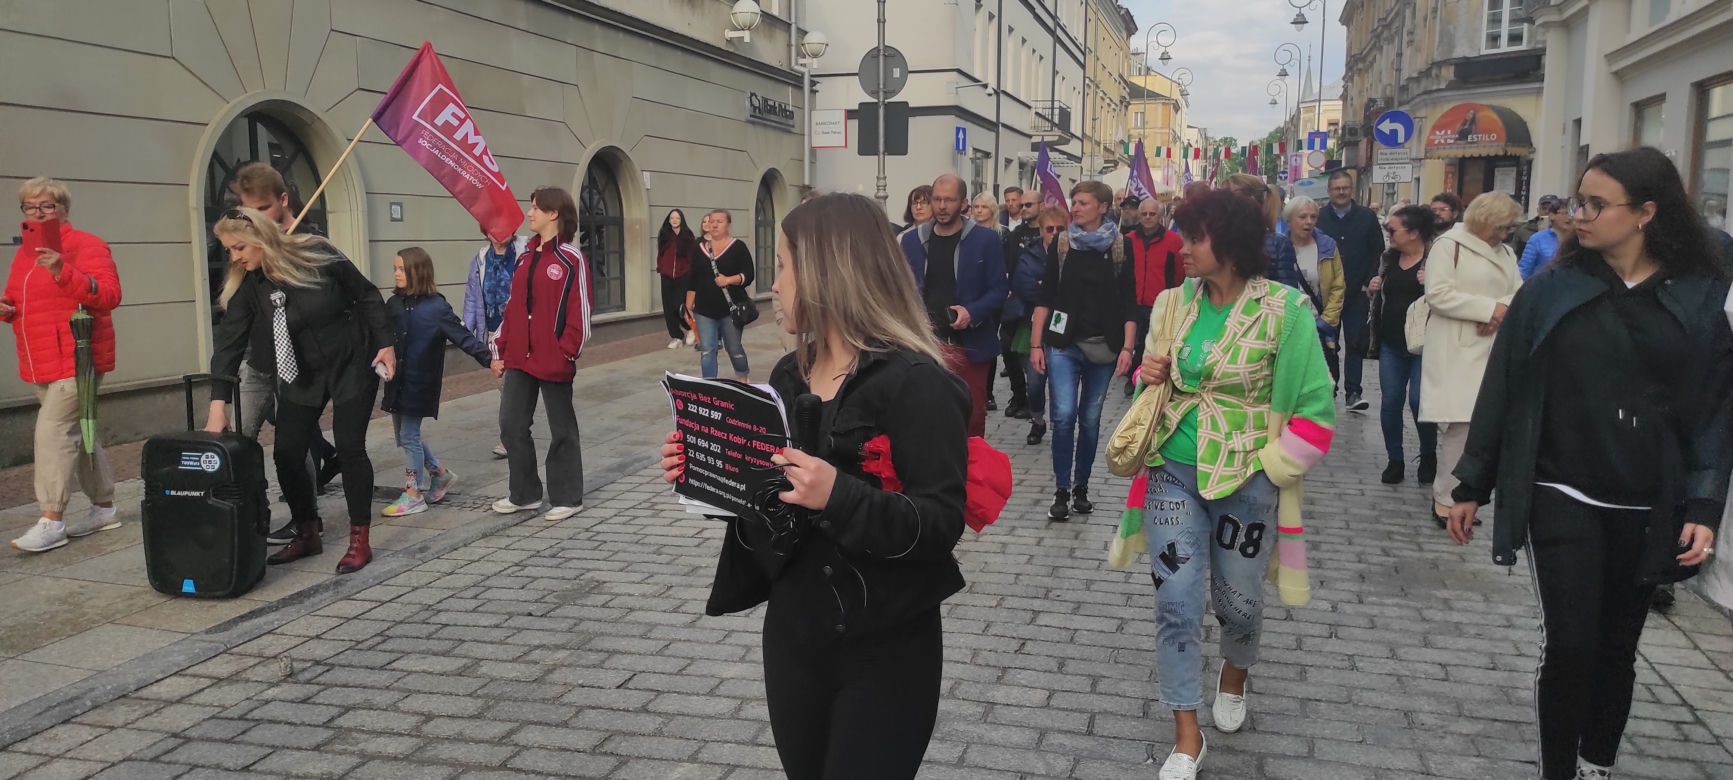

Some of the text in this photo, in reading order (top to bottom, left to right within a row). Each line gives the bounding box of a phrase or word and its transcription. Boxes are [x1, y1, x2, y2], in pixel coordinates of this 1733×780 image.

[420, 129, 459, 161] FEDERACJA
[433, 102, 500, 172] FMS
[1467, 133, 1497, 142] ESTILO
[417, 137, 485, 190] SOCJALDEMOKRATÓW
[687, 403, 698, 413] 222
[698, 406, 709, 417] 922
[710, 410, 722, 420] 597
[712, 397, 735, 410] Granic
[701, 425, 709, 433] na
[710, 427, 728, 440] Rzecz
[686, 434, 697, 445] 501
[697, 438, 709, 449] 694
[709, 442, 721, 453] 202
[687, 448, 695, 458] 22
[1168, 499, 1187, 511] GOT
[1216, 513, 1266, 559] 08
